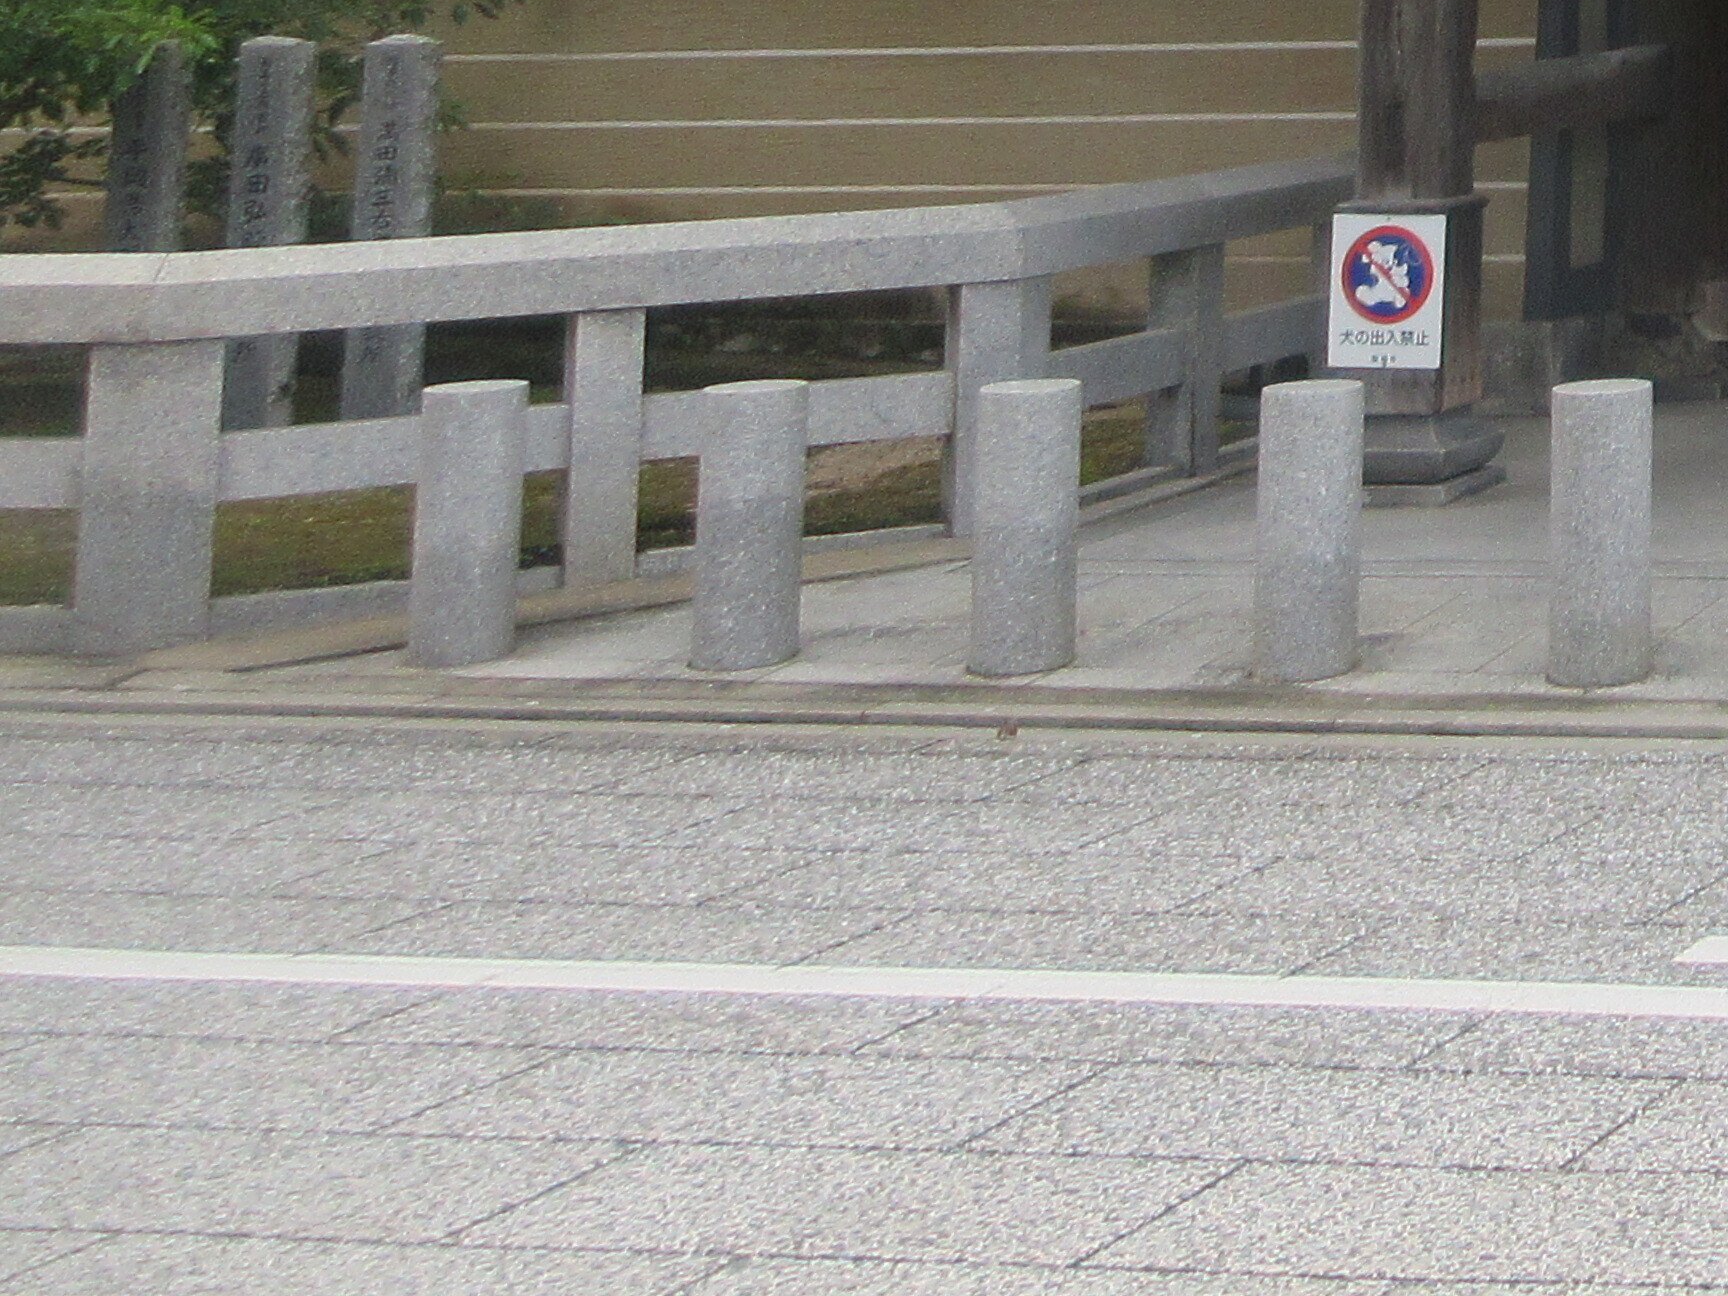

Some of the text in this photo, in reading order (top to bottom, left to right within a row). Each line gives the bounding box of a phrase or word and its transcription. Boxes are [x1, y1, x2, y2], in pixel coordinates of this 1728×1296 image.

[1339, 329, 1430, 346] 犬の出入禁止
